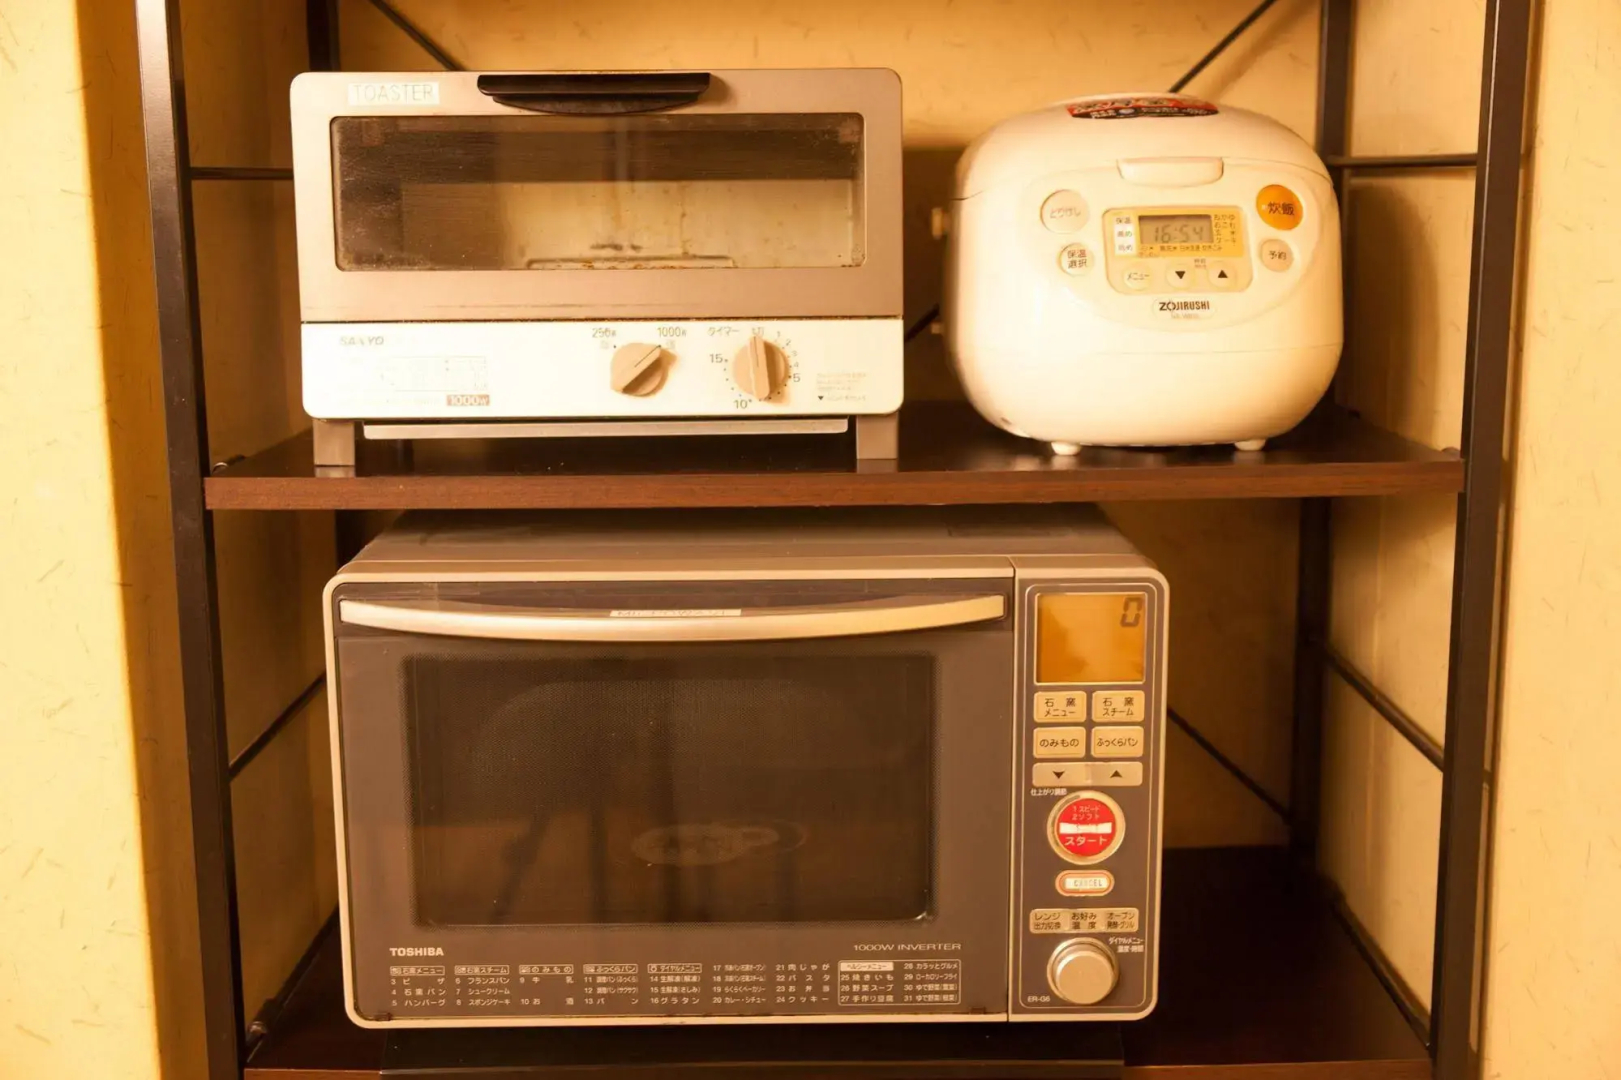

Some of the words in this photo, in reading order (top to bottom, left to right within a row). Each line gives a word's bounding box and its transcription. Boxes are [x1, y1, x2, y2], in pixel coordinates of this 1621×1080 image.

[353, 84, 433, 102] TOASTER
[1267, 201, 1295, 215] 炊飯
[1154, 225, 1204, 243] 16:54
[1067, 250, 1088, 259] 保温
[1269, 250, 1287, 261] 予約
[1159, 300, 1210, 312] ZOJIRUSHI
[707, 326, 740, 336] タイマー
[709, 353, 723, 364] 15
[792, 372, 801, 383] 5
[734, 400, 748, 410] 10
[1120, 596, 1143, 628] 0
[1044, 708, 1076, 717] メニュー
[1102, 707, 1134, 717] スチーム
[1039, 738, 1080, 748] のみもの
[1096, 737, 1138, 747] ふっくらパン
[1064, 836, 1107, 846] スタート
[1034, 912, 1061, 920] レンジ
[1071, 912, 1097, 920] お好み
[1106, 912, 1135, 920] オーブン
[1108, 936, 1144, 944] ダイヤルメニュー
[853, 943, 894, 951] 1000W
[897, 943, 962, 951] INVERTER
[389, 947, 444, 957] TOSHIBA
[531, 965, 573, 974] のみもの
[596, 965, 636, 974] ふっくらパン
[916, 962, 957, 970] カラッとグルメ
[467, 977, 510, 985] フランスパン
[788, 974, 830, 982] パスタ
[852, 984, 894, 992] 野菜スープ
[404, 999, 446, 1007] ハンバーグ
[468, 998, 510, 1006] スポンジケーキ
[660, 997, 700, 1005] グラタン
